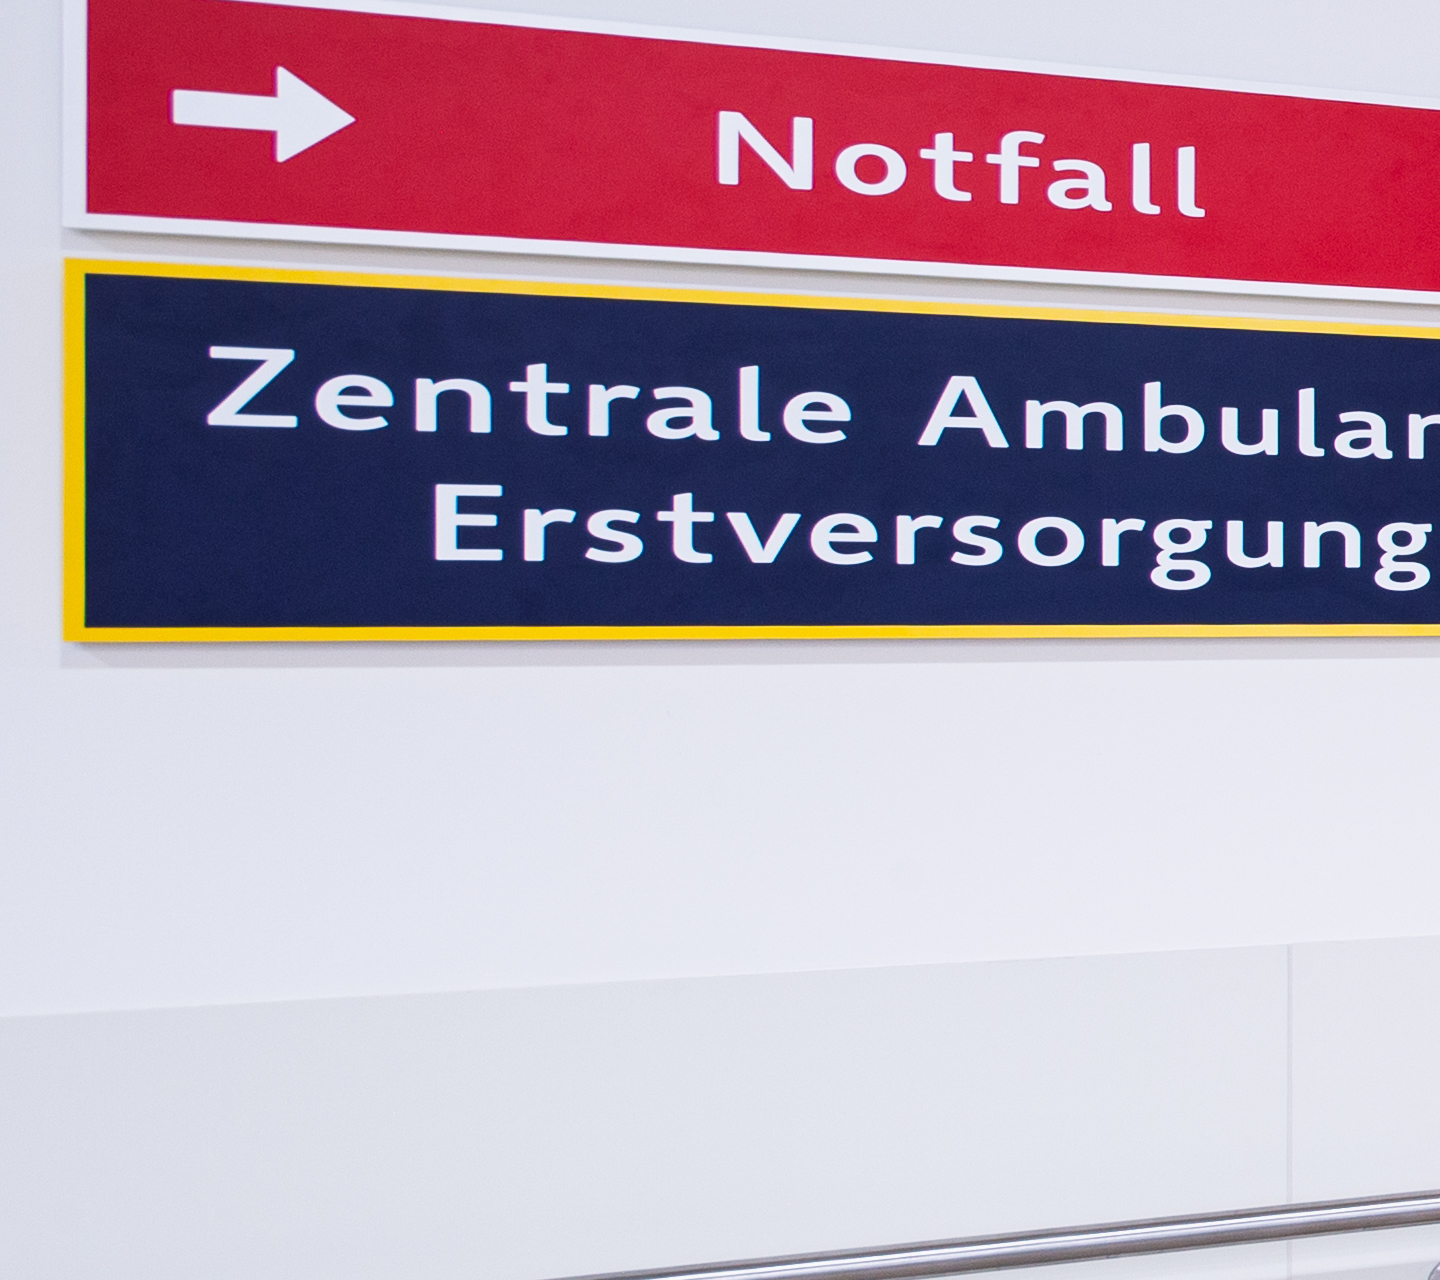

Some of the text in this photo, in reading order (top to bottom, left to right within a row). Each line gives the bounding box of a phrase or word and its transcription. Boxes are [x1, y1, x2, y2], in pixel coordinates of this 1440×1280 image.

[717, 109, 1207, 219] Notfall
[206, 344, 852, 445] Zentrale
[434, 482, 1433, 593] Erstversorgung
